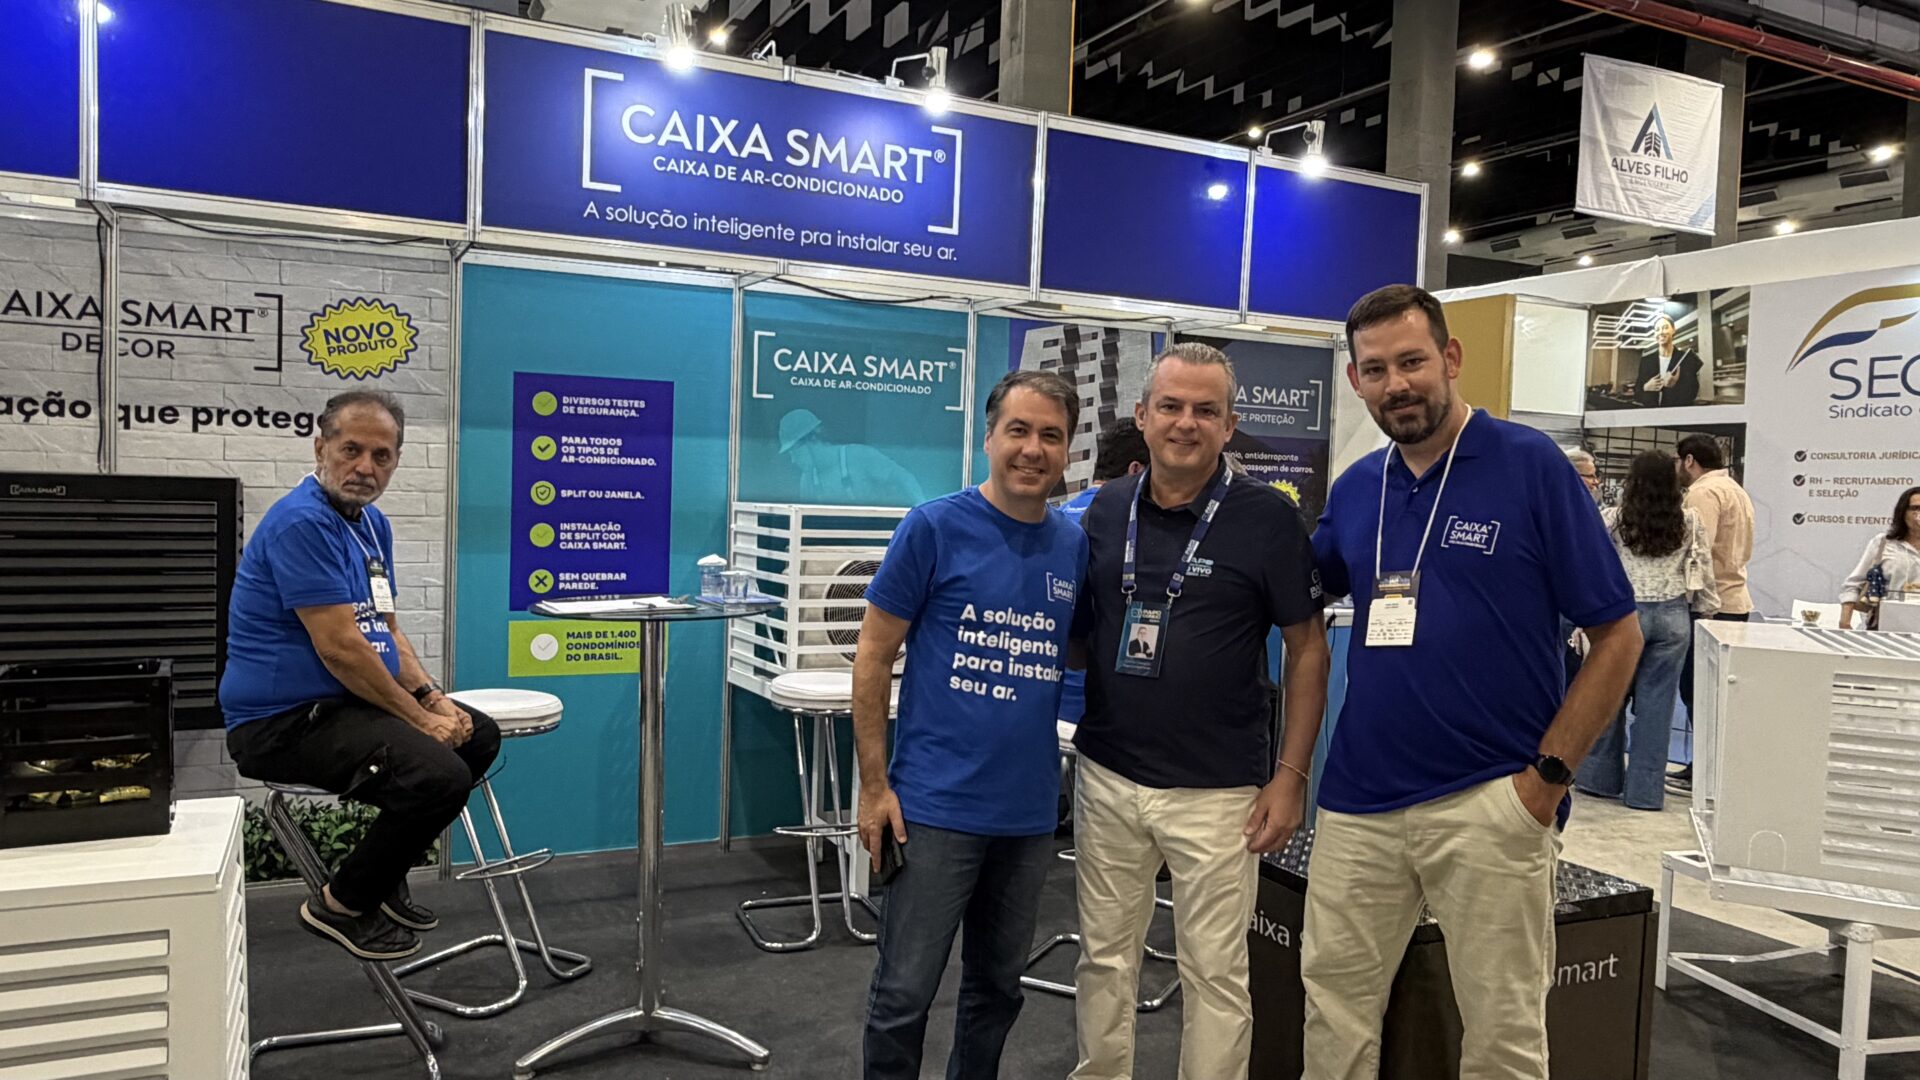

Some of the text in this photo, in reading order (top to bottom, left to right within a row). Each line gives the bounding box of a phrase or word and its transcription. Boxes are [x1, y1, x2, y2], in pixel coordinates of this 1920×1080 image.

[621, 103, 773, 163] CAIXA
[1611, 157, 1651, 176] ALVES
[1654, 165, 1689, 184] FILHO
[653, 155, 904, 204] CAIXA DE AR-CONDICIONADO
[583, 200, 957, 262] A solução inteligente pra instalar seu ar.
[0, 289, 101, 321] AIXA
[323, 320, 394, 346] NOVO
[327, 337, 398, 357] PRODUTO
[773, 348, 857, 376] CAIXA
[790, 376, 931, 395] CAIXA DE AR-CONDICIONADO
[562, 396, 645, 408] DIVERSOS TESTES
[0, 391, 323, 437] ação que proteg
[562, 406, 640, 418] DE SEGURANÇA.
[1828, 403, 1913, 420] Sindicato
[1249, 412, 1295, 426] PROTEÇÃO
[561, 436, 622, 446] PARA TODOS
[561, 445, 620, 455] OS TIPOS DE
[1810, 449, 1920, 460] CONSULTORIA JURÍDIC
[561, 455, 657, 466] AR-CONDICIONADO.
[1280, 464, 1289, 473] de
[1809, 476, 1822, 485] RH
[1833, 477, 1914, 486] RECRUTAMENTO
[560, 489, 645, 500] SPLIT OU JANELA.
[1808, 488, 1859, 499] E SELEÇÃO
[1807, 515, 1845, 524] CURSOS
[1847, 516, 1853, 524] E
[560, 521, 621, 533] INSTALAÇÃO
[1454, 520, 1488, 534] CAIXA
[560, 532, 625, 541] DE SPLIT COM
[1449, 530, 1489, 544] SMART
[559, 541, 628, 550] CAIXA SMART.
[559, 572, 627, 581] SEM QUEBRAR
[559, 582, 599, 590] PAREDE.
[960, 603, 1056, 632] A solução
[566, 630, 637, 640] MAIS DE 1.400
[957, 625, 1059, 658] inteligente
[566, 652, 623, 662] DO BRASIL.
[952, 652, 1003, 673] para
[949, 675, 1017, 701] seu ar.
[1248, 909, 1290, 948] aixa
[1551, 953, 1619, 987] mart
